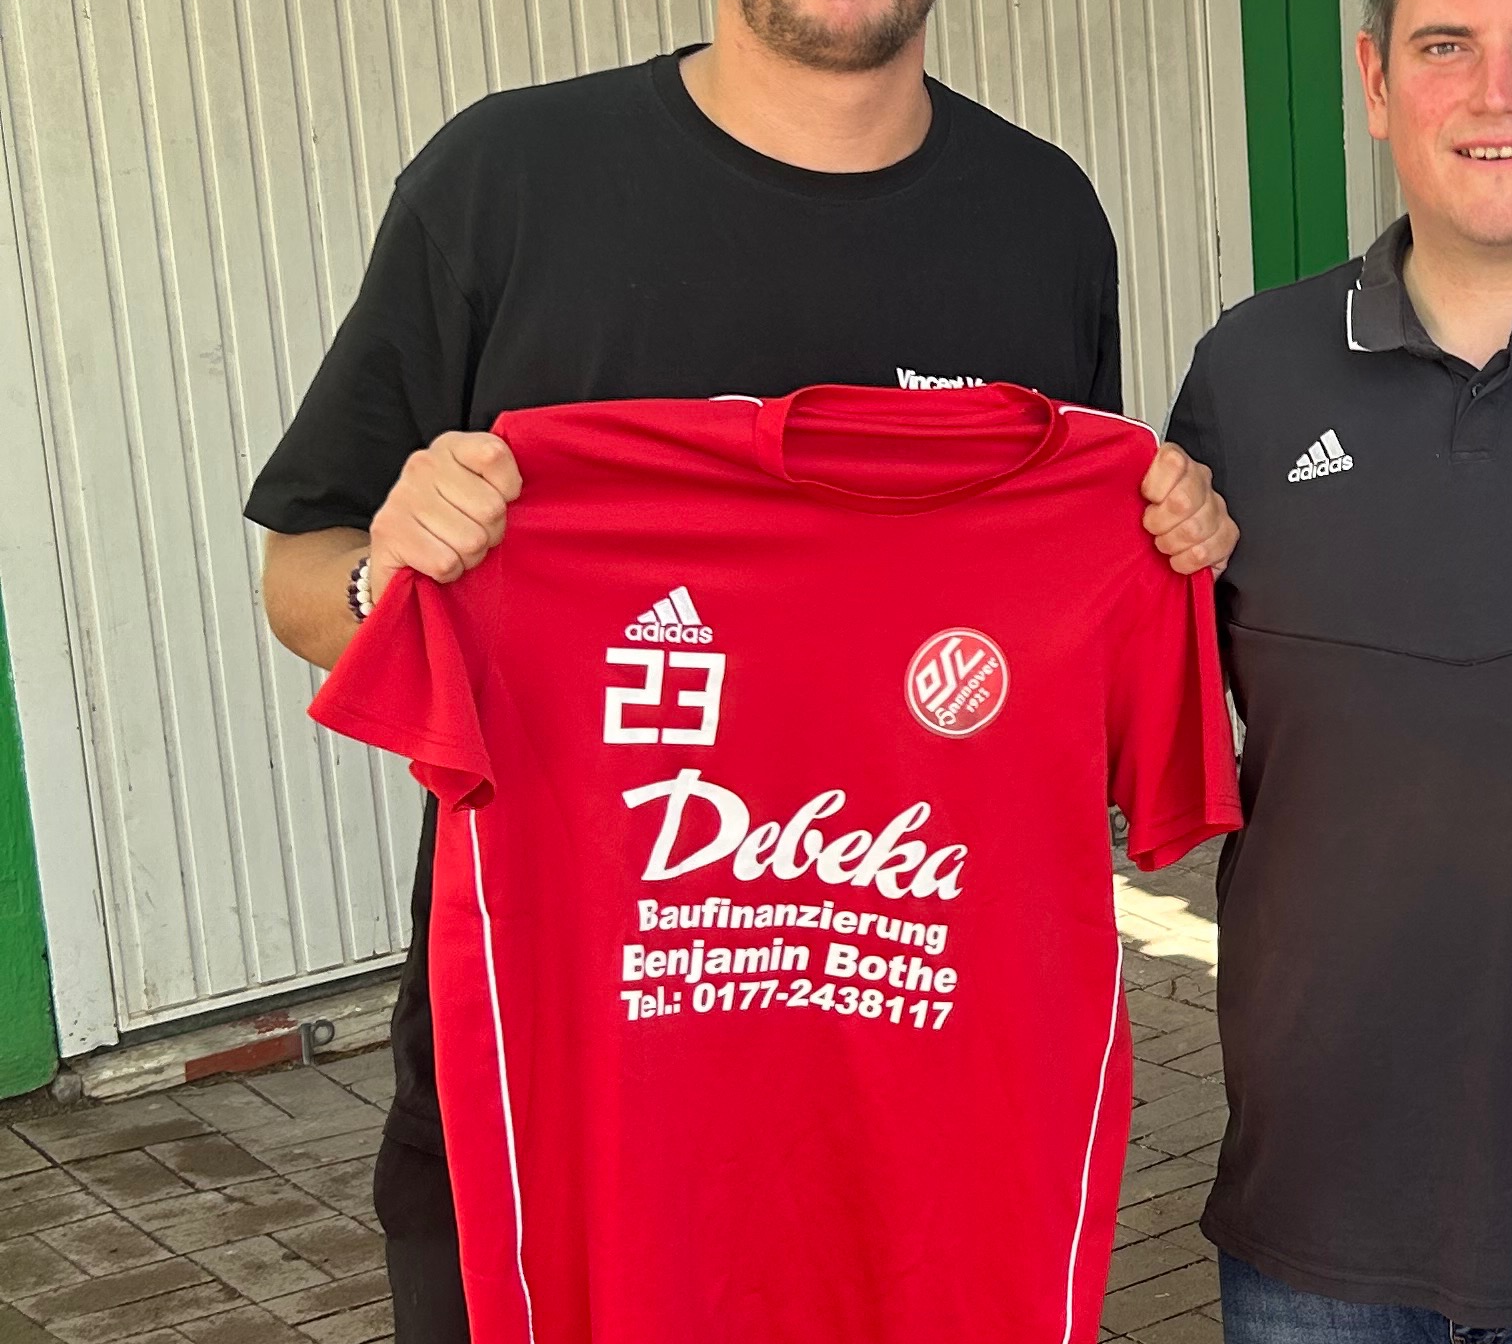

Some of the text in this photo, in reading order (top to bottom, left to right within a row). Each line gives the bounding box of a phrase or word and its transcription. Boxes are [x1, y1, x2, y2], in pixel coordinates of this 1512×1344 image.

[1287, 454, 1354, 483] adidas
[624, 619, 713, 644] adidas
[603, 648, 726, 746] 23
[622, 768, 968, 901] Debeka
[637, 897, 949, 956] Baufinanzierung
[621, 938, 958, 994] Benjamin Bothe
[620, 978, 954, 1031] Tel.: 0177-2438117
